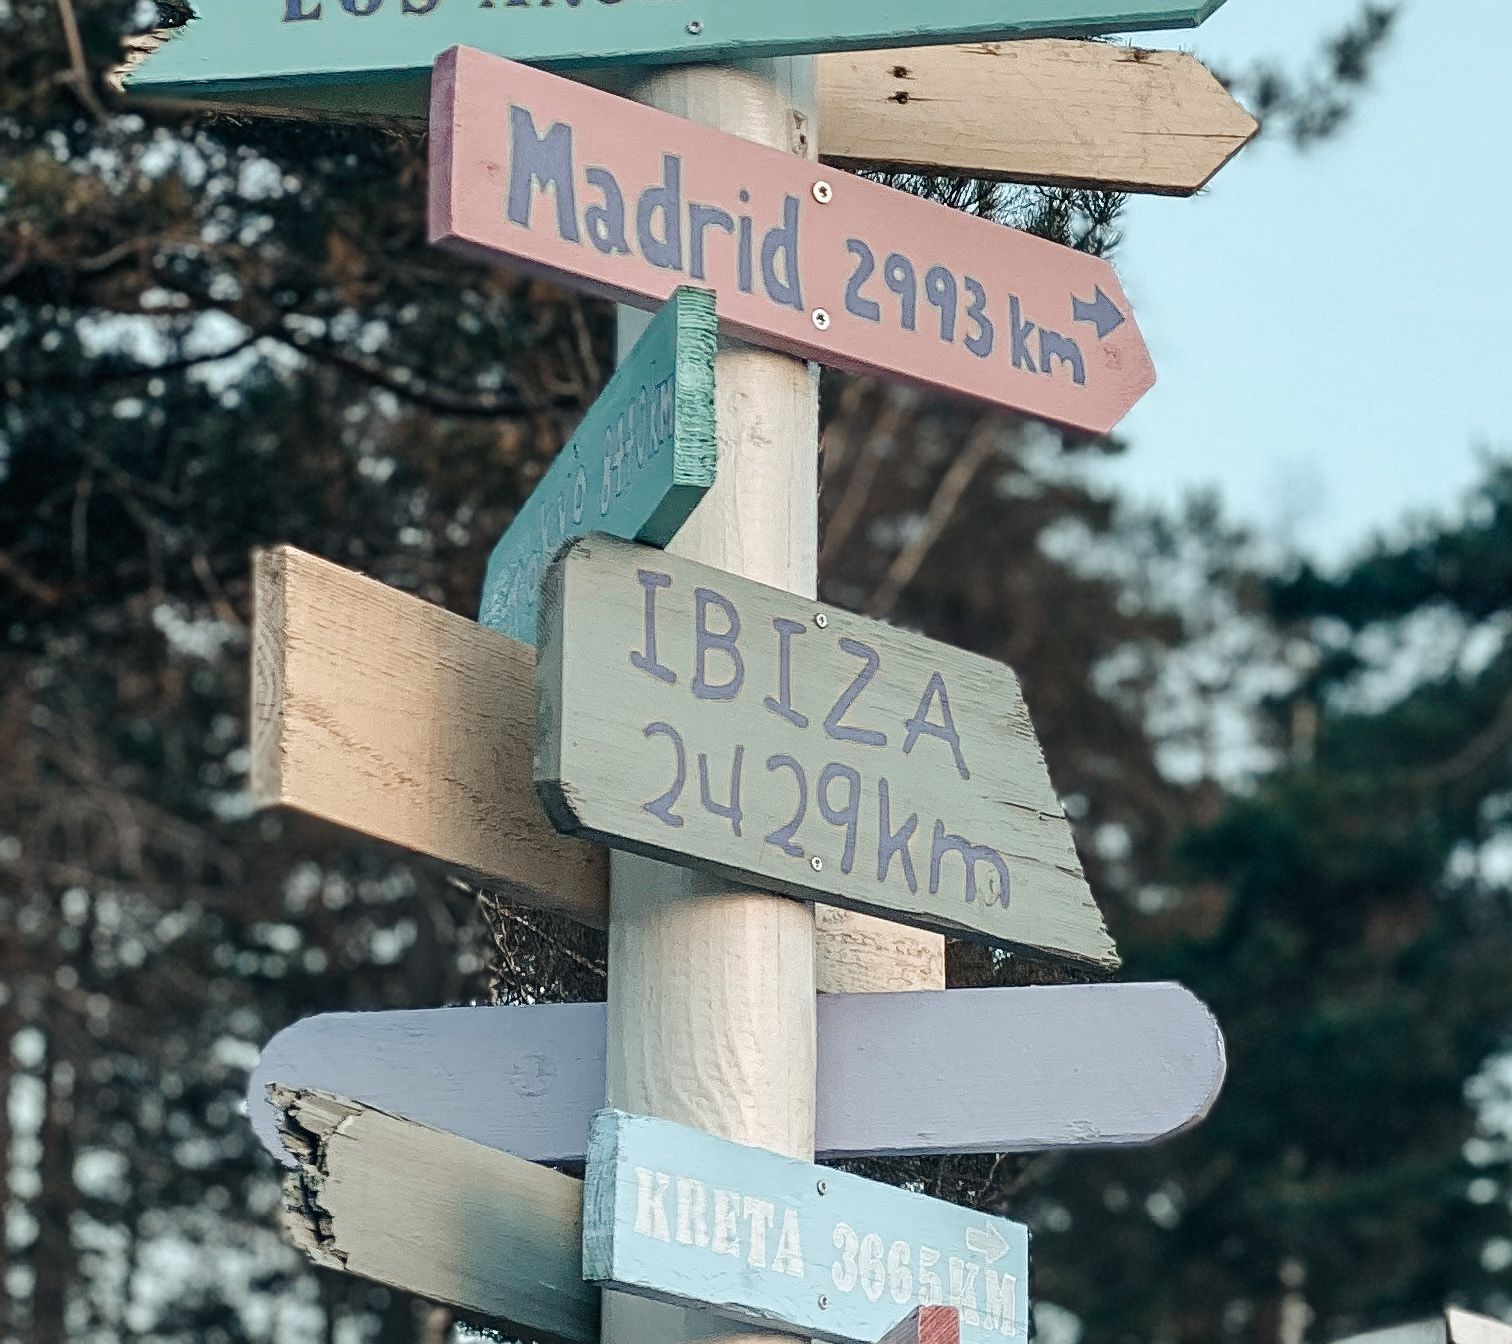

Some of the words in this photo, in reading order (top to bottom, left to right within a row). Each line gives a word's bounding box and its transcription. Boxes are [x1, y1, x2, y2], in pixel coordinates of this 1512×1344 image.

[508, 105, 801, 311] Madrid
[845, 238, 993, 358] 2993
[1009, 293, 1086, 385] km
[631, 569, 970, 779] IBIZA
[643, 722, 1009, 908] 2429km
[632, 1168, 803, 1276] KRETA
